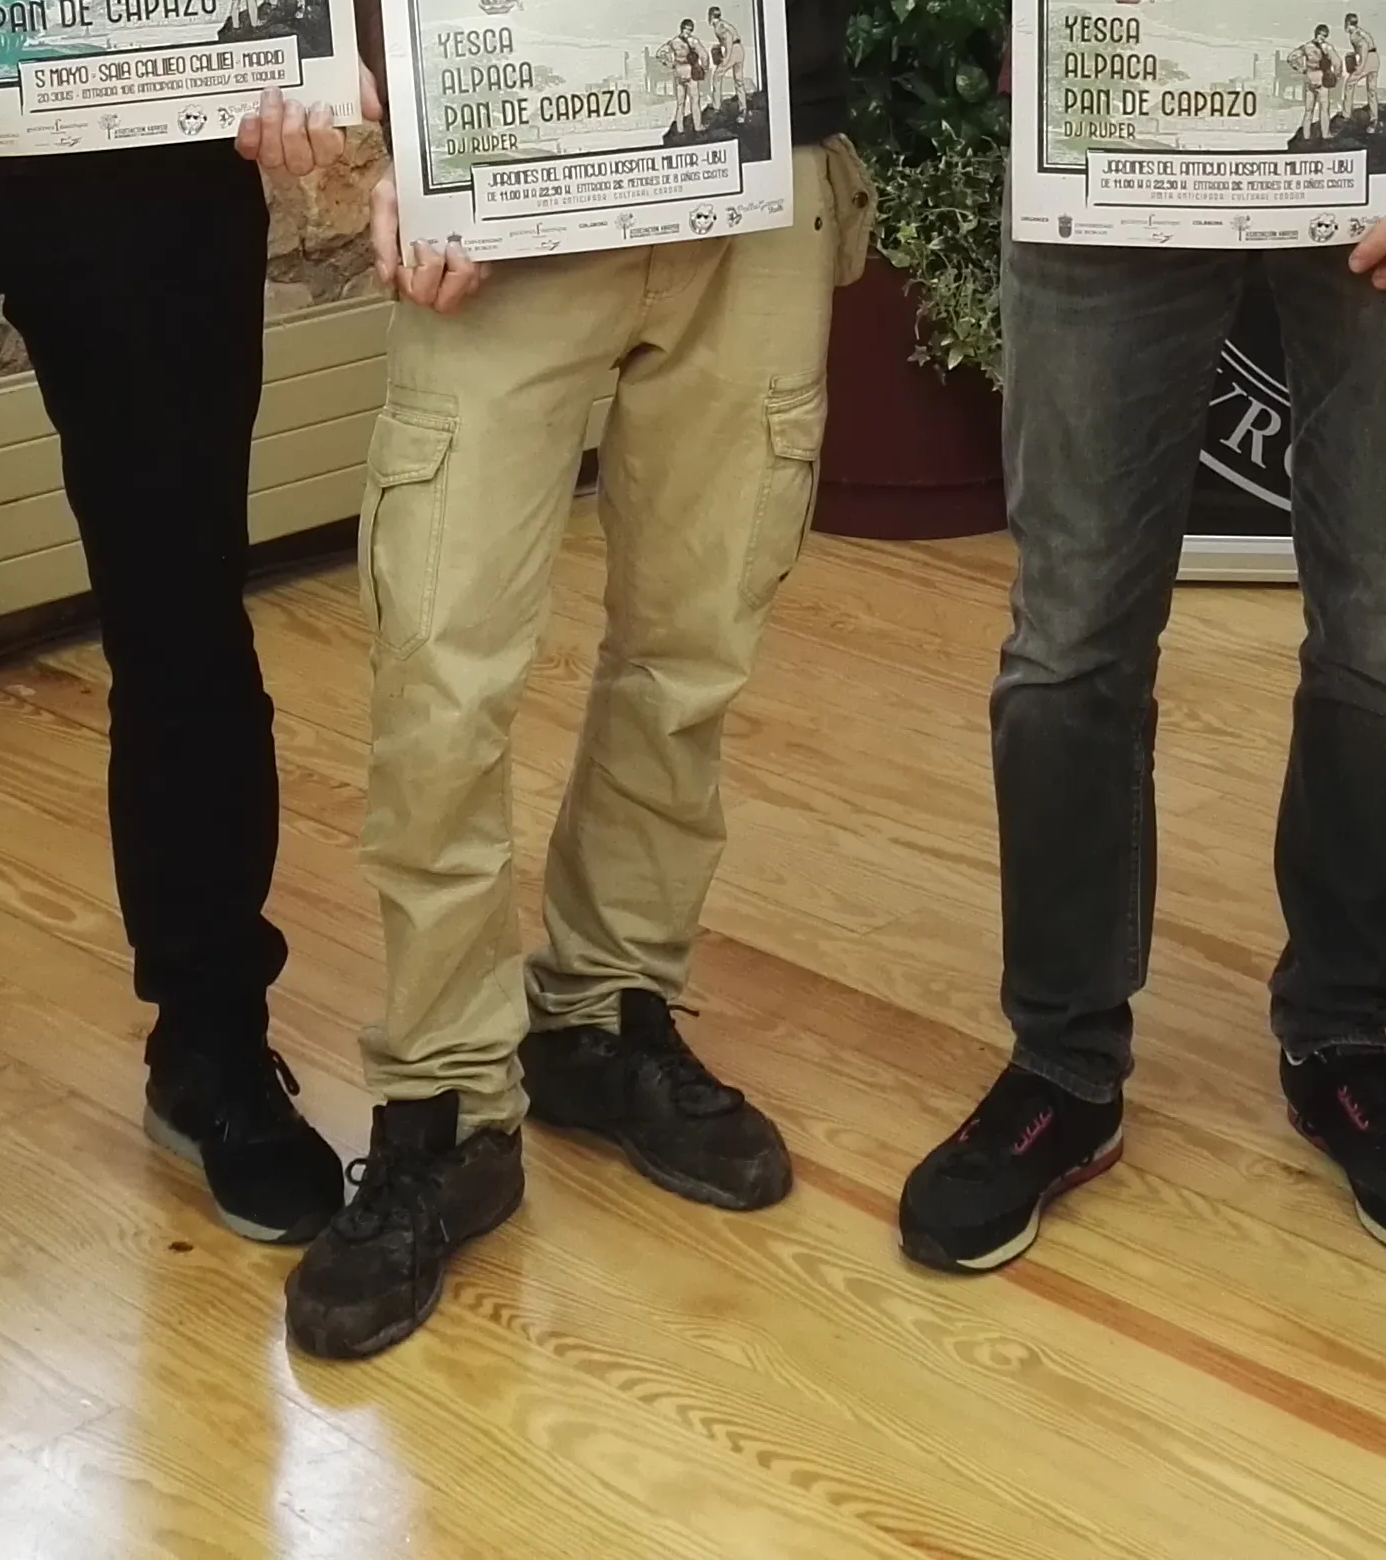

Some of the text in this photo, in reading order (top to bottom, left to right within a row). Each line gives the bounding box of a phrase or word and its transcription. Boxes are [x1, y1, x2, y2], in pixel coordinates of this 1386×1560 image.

[438, 26, 514, 59] YESCA
[1065, 16, 1140, 43] YESCA
[50, 65, 89, 88] MAYO
[441, 61, 533, 95] ALPACA
[1065, 52, 1157, 80] ALPACA
[444, 89, 632, 133] PAN DE CAPAZO
[1064, 88, 1257, 116] PAN DE CAPAZO
[447, 132, 518, 156] DJ RUPER
[1064, 122, 1135, 138] DJ RUPER
